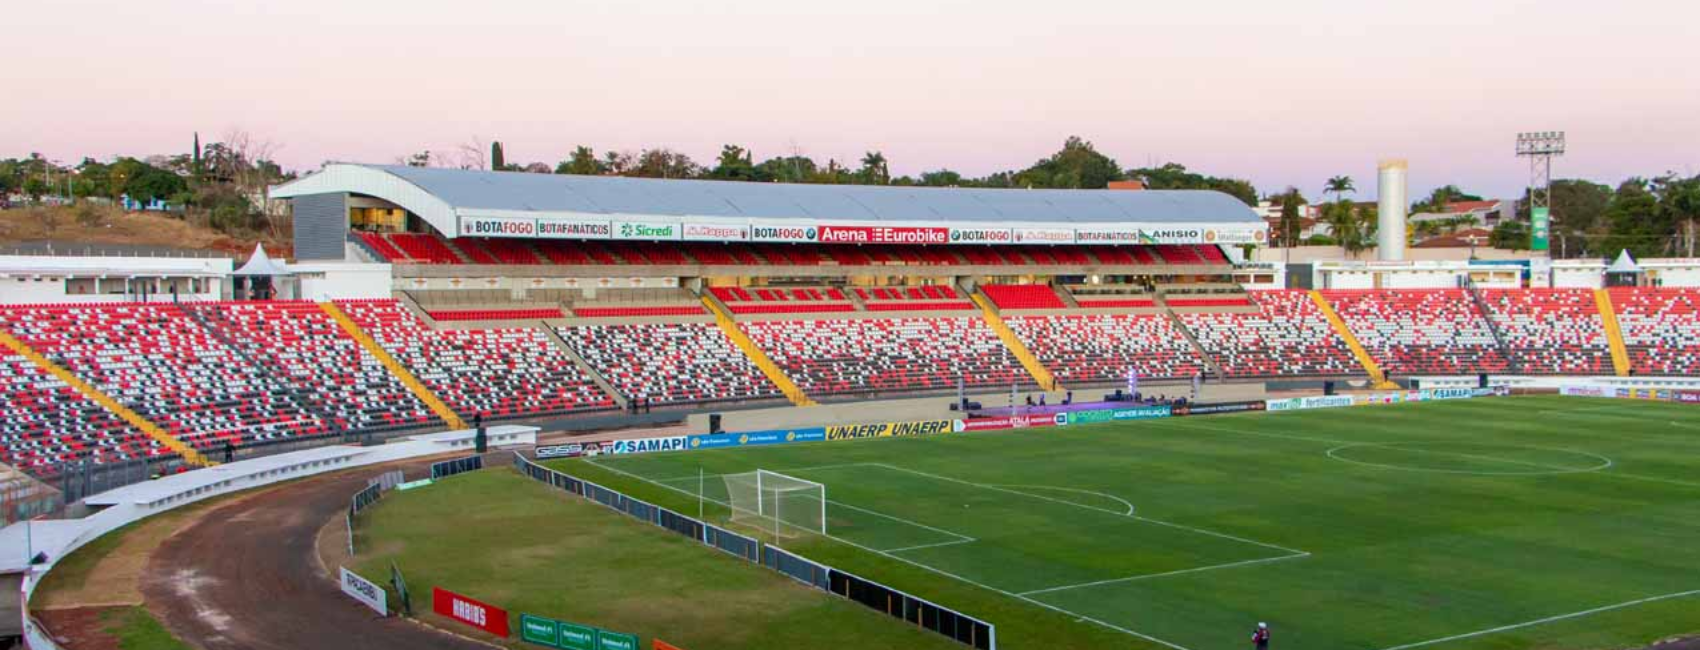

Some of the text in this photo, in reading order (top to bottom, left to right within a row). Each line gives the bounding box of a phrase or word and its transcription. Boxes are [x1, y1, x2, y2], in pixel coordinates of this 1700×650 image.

[475, 221, 533, 234] BOTAFOGO
[635, 225, 673, 237] Sicredi
[754, 228, 804, 239] BOTAFOGO
[822, 227, 945, 242] Arena Eurobike
[962, 230, 1009, 240] BOTAFOGO
[1152, 230, 1199, 238] ANISIO
[828, 420, 948, 439] UNAERP UNAERP
[626, 438, 686, 452] SAMAPI
